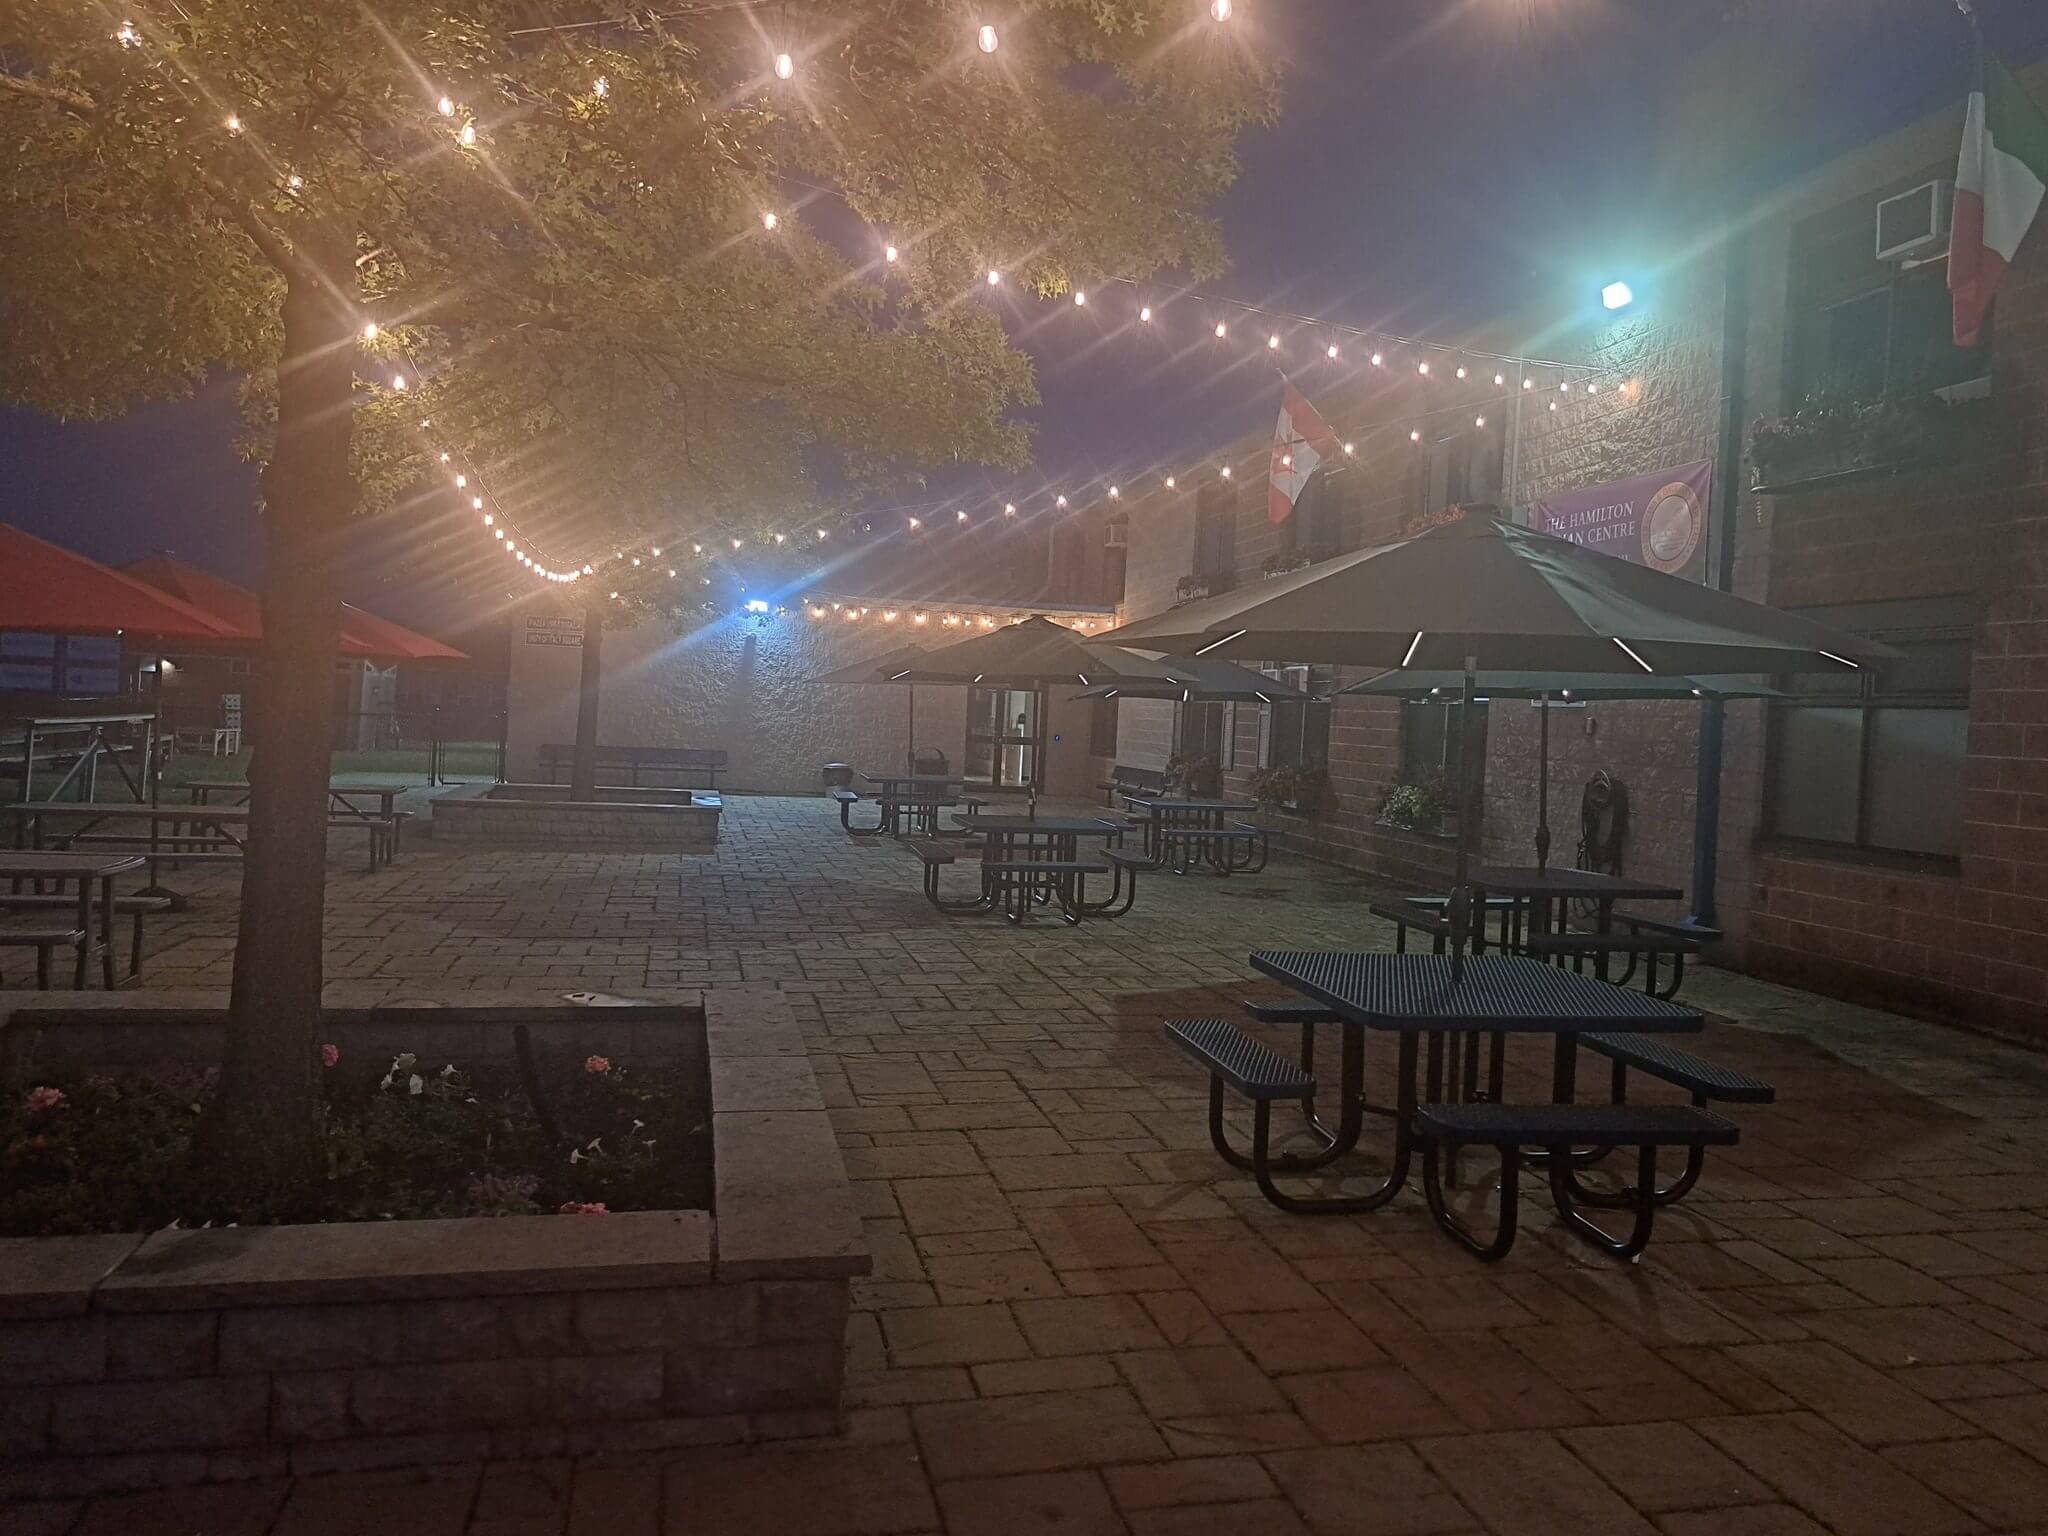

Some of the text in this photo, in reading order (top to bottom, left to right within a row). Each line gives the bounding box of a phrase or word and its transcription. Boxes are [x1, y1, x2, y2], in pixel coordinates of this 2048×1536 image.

[1545, 501, 1635, 533] THE HAMILTON
[1587, 521, 1636, 543] CENTRE
